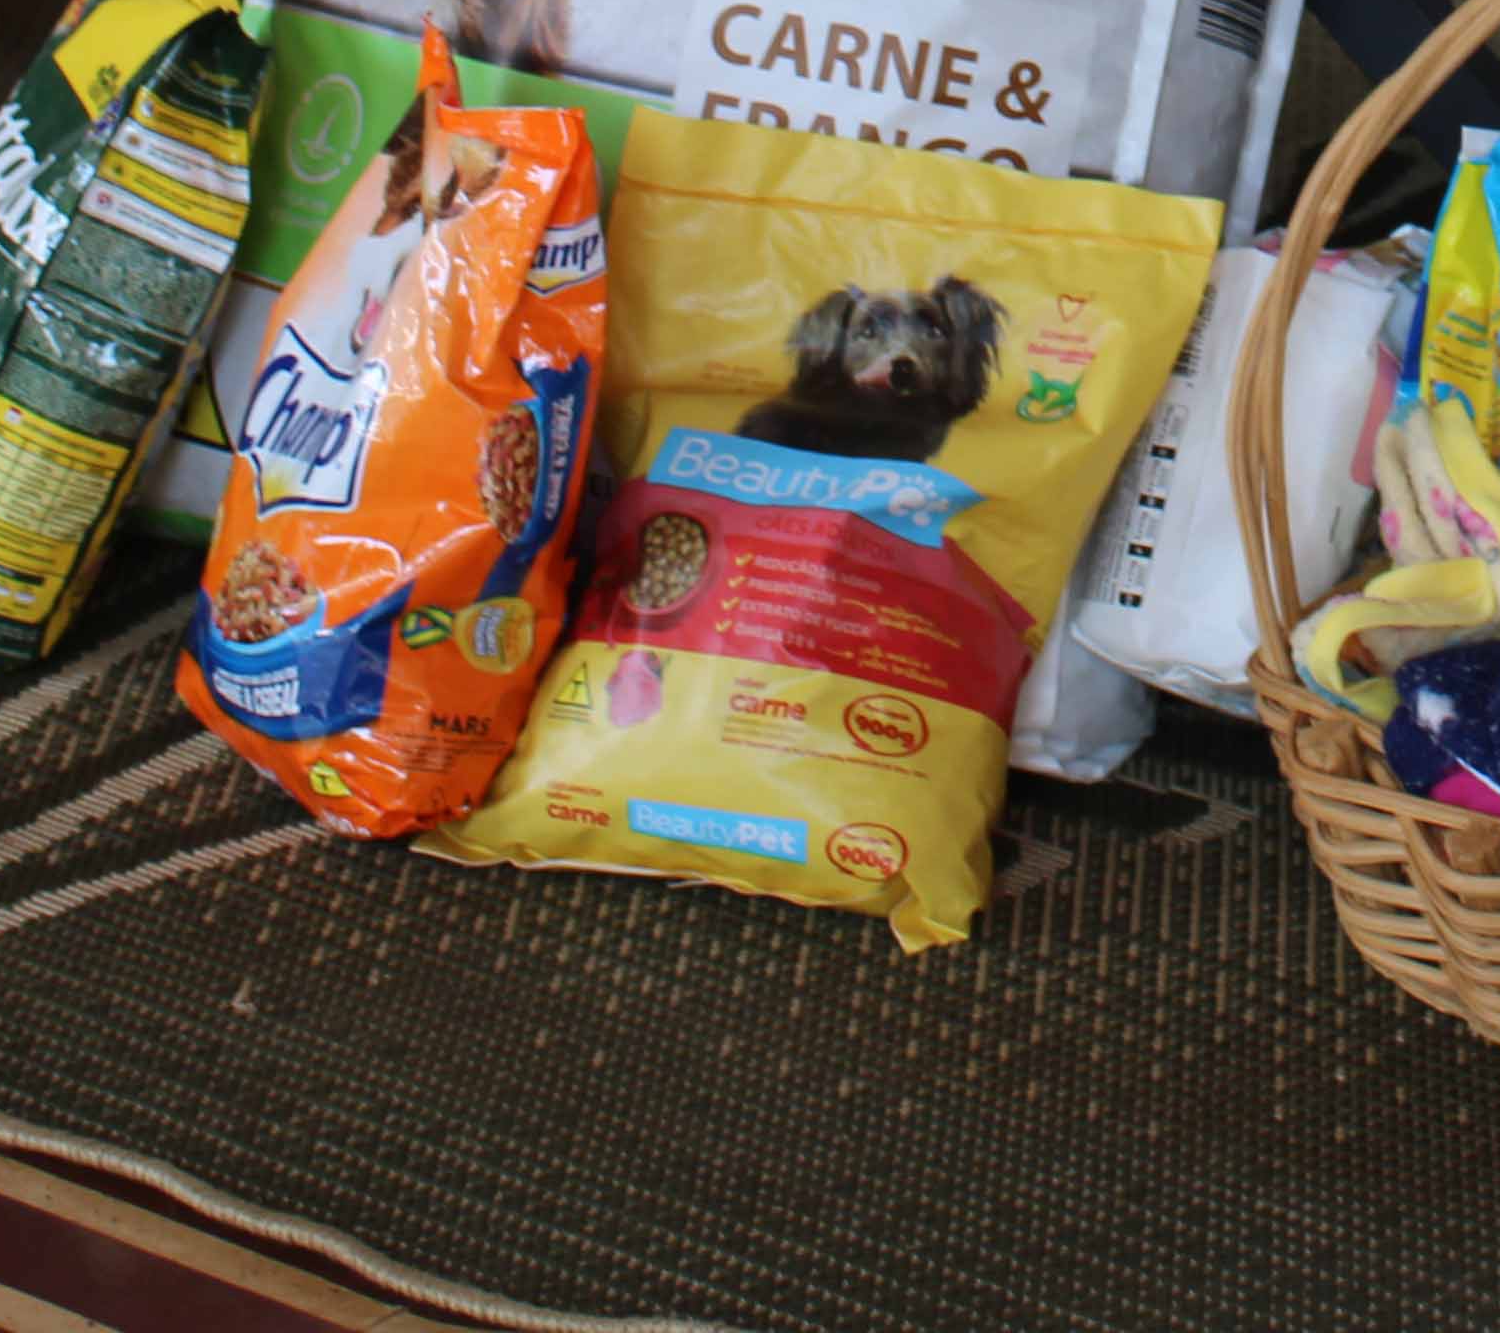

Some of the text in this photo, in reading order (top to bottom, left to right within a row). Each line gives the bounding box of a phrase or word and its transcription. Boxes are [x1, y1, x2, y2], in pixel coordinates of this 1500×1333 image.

[709, 2, 1054, 128] CARNE &
[729, 693, 808, 722] carne
[429, 713, 494, 734] MARS
[854, 712, 916, 751] 900g
[546, 801, 611, 828] carne
